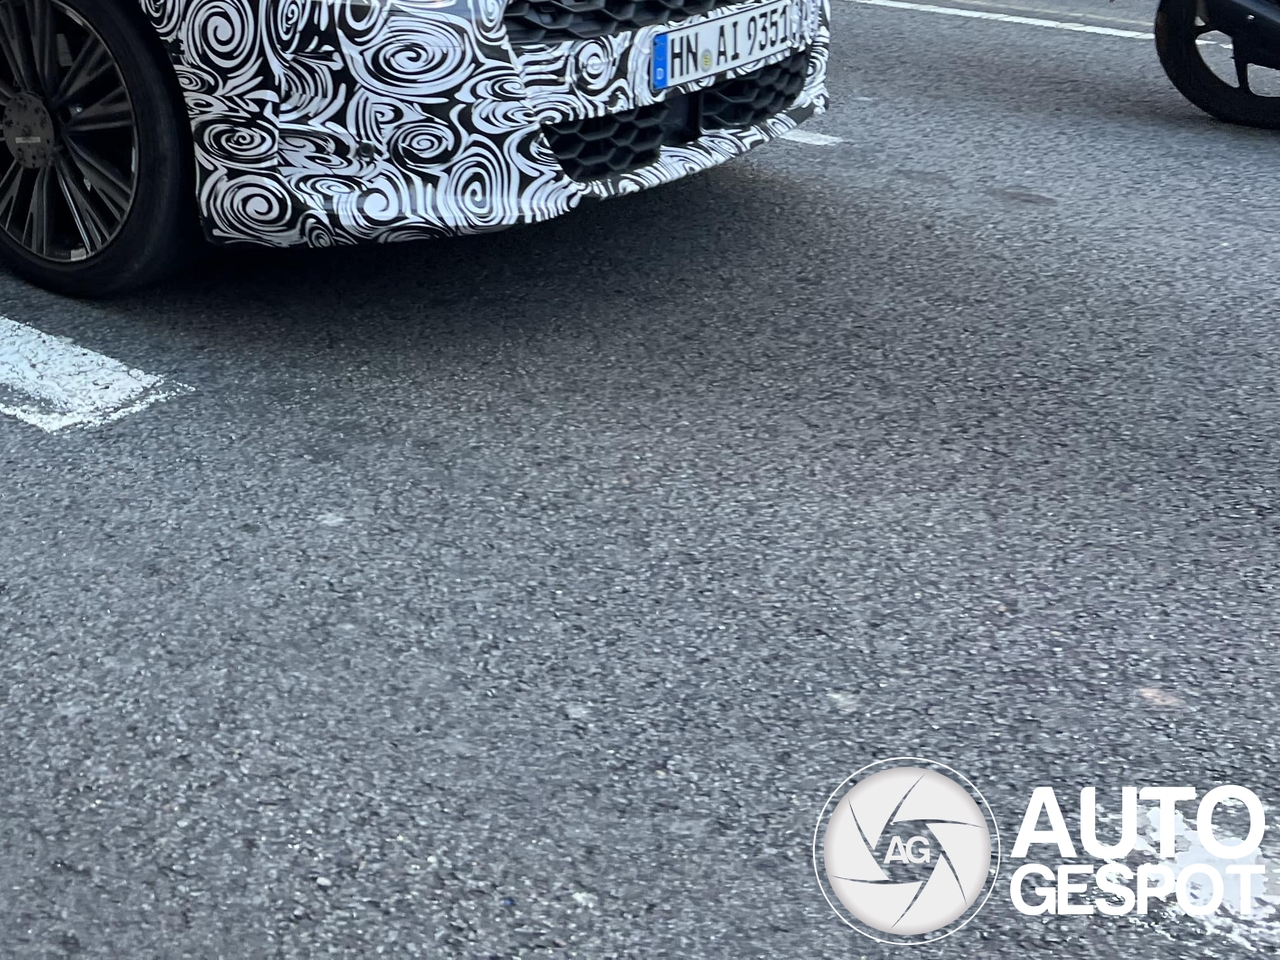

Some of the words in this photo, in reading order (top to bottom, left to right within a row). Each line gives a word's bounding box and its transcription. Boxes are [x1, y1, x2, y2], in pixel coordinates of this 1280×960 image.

[670, 32, 699, 79] HN
[716, 21, 740, 66] AI
[747, 4, 790, 57] 9351
